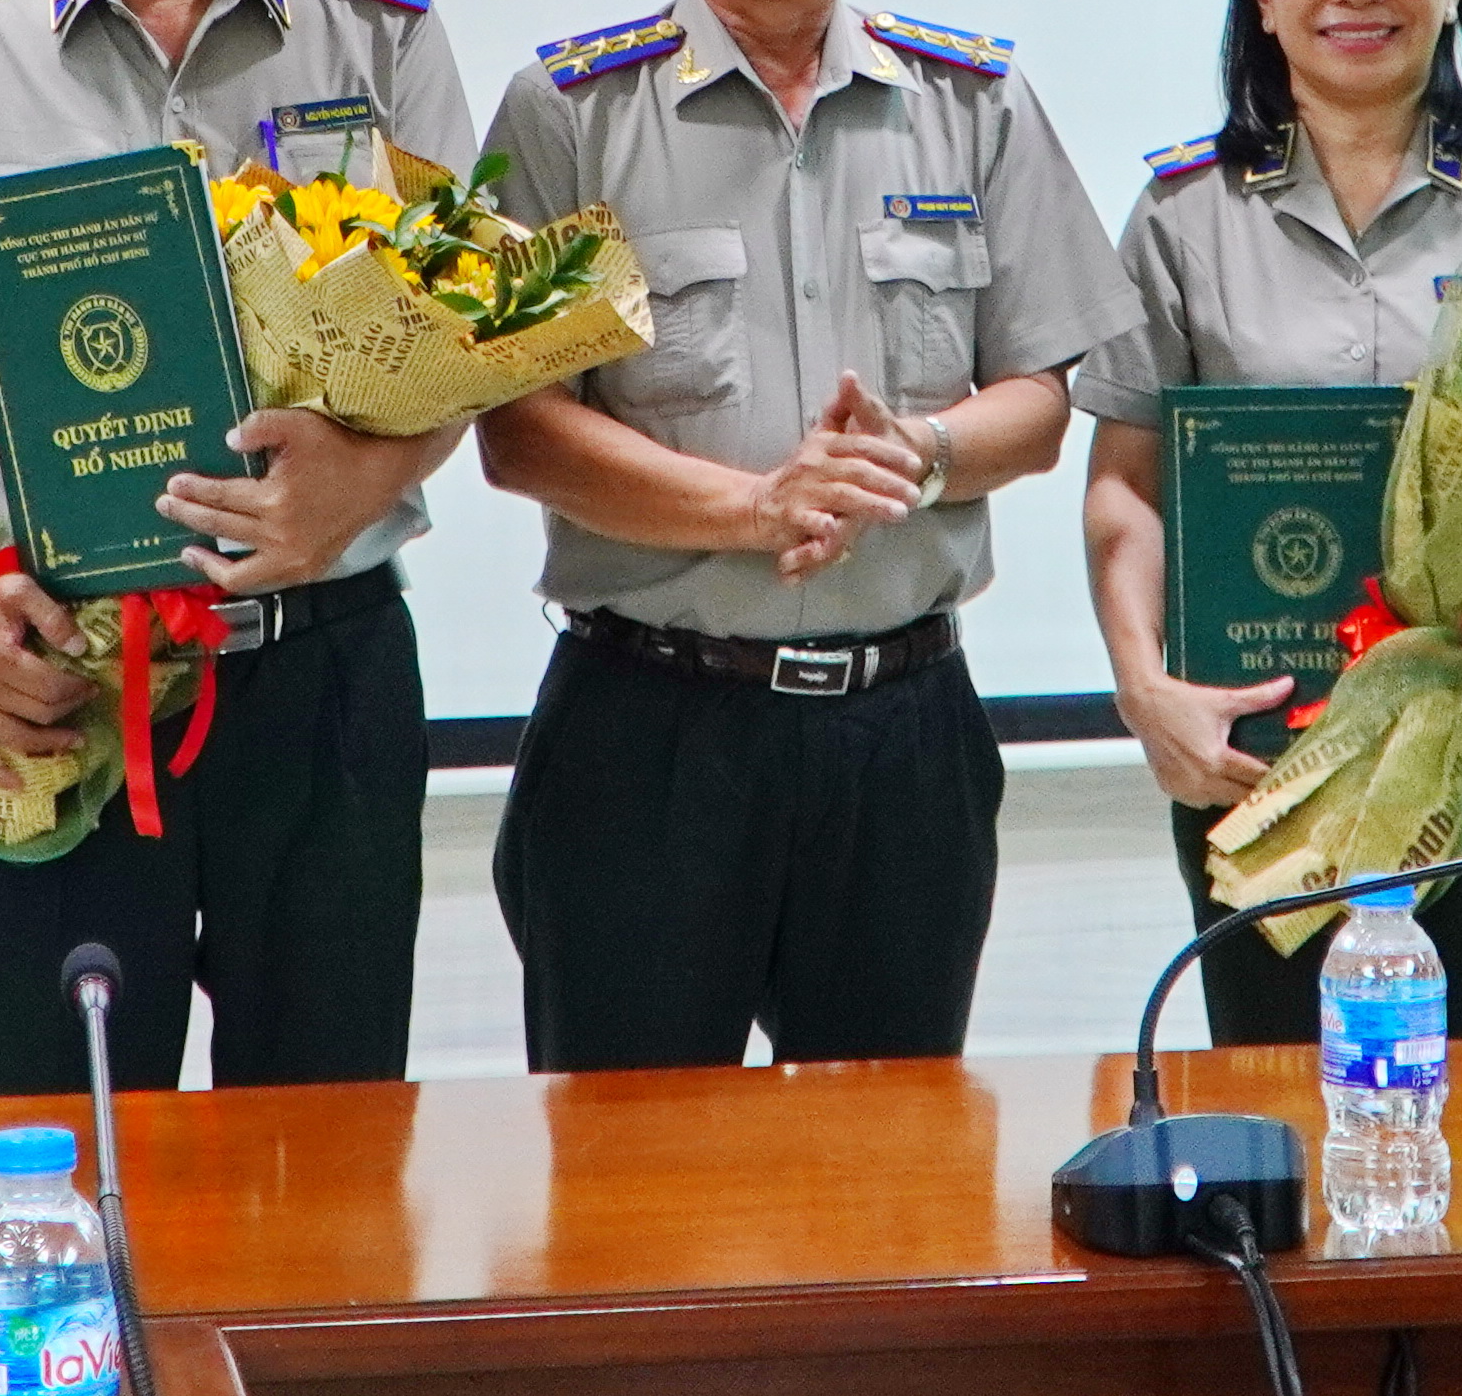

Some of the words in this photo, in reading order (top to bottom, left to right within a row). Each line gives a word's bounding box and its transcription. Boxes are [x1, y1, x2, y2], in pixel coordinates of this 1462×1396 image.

[50, 230, 70, 242] THI
[40, 247, 59, 260] THI
[121, 247, 150, 261] MINH
[52, 412, 129, 451] QUYẾT
[132, 406, 194, 435] ĐỊNH
[70, 445, 105, 477] BỔ
[109, 440, 188, 471] NHIỆM
[1226, 616, 1307, 643] QUYẾT
